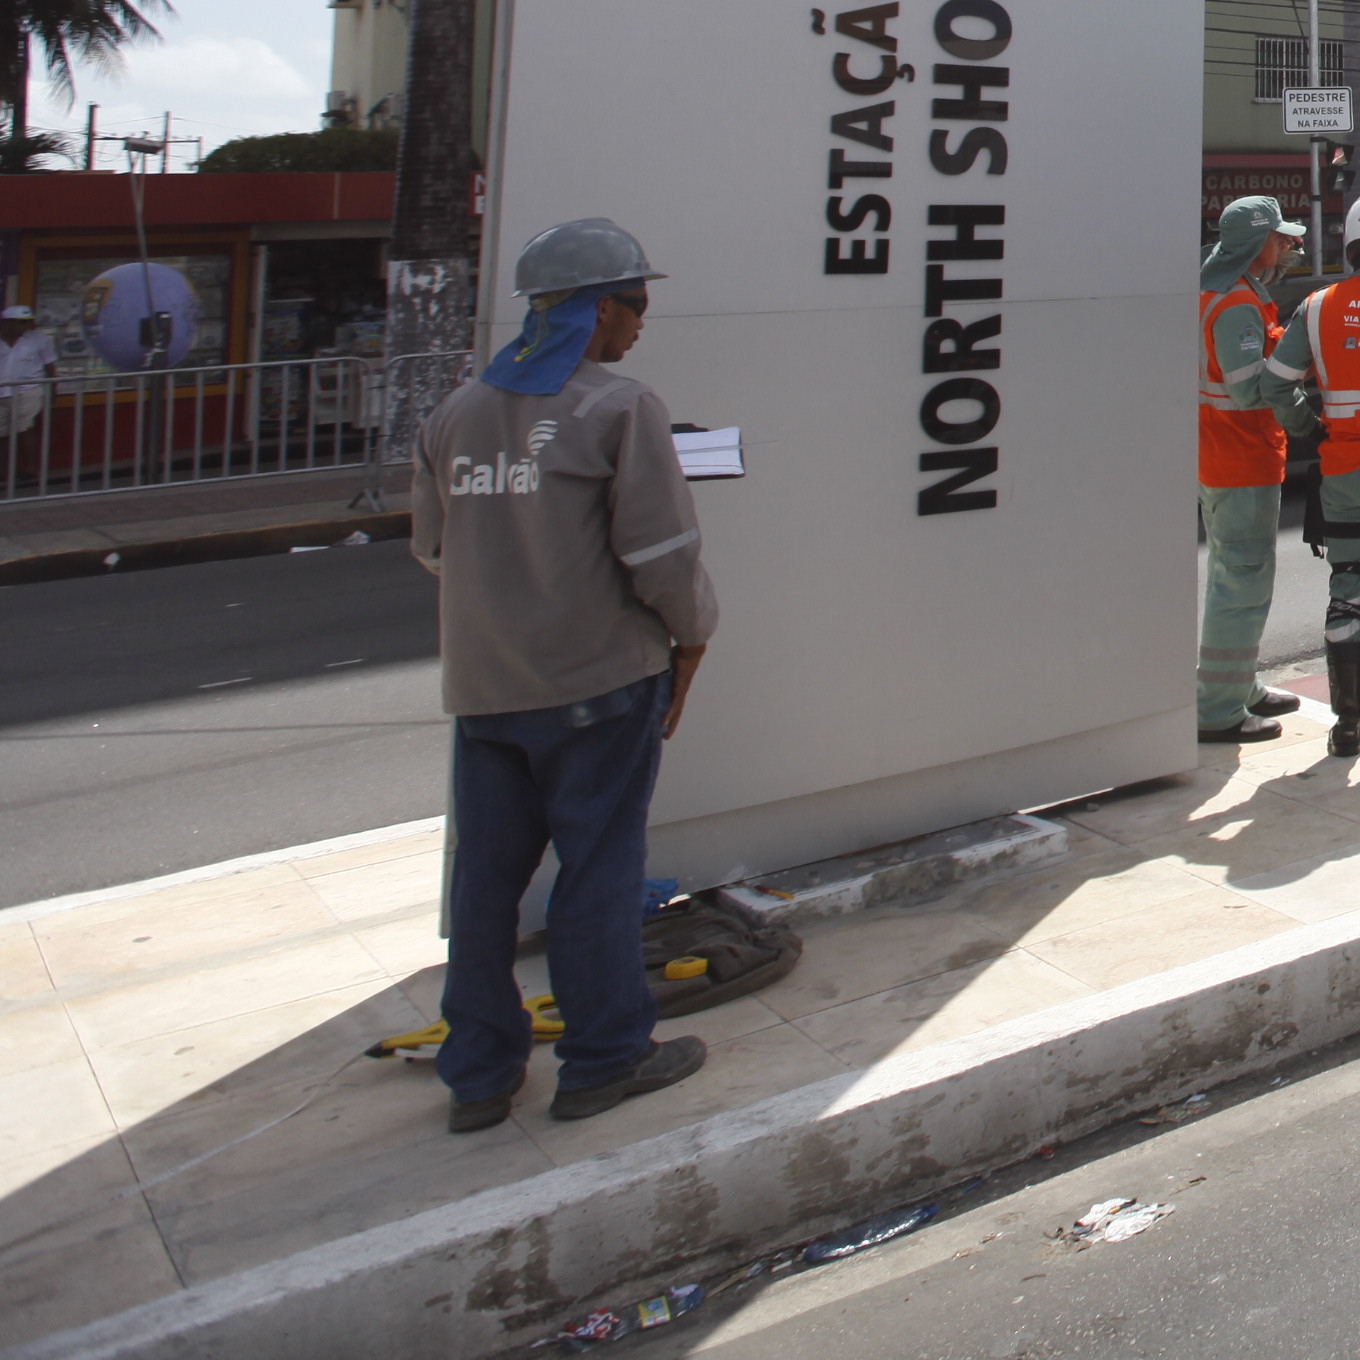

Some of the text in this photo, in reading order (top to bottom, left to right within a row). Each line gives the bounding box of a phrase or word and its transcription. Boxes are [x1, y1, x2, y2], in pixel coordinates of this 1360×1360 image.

[1289, 93, 1346, 102] PEDESTRE
[1292, 107, 1344, 115] ATRAVESSE
[1205, 174, 1303, 190] CARBONO
[1343, 315, 1359, 323] VIA
[917, 203, 1007, 517] NORTH
[449, 451, 540, 497] Galvão
